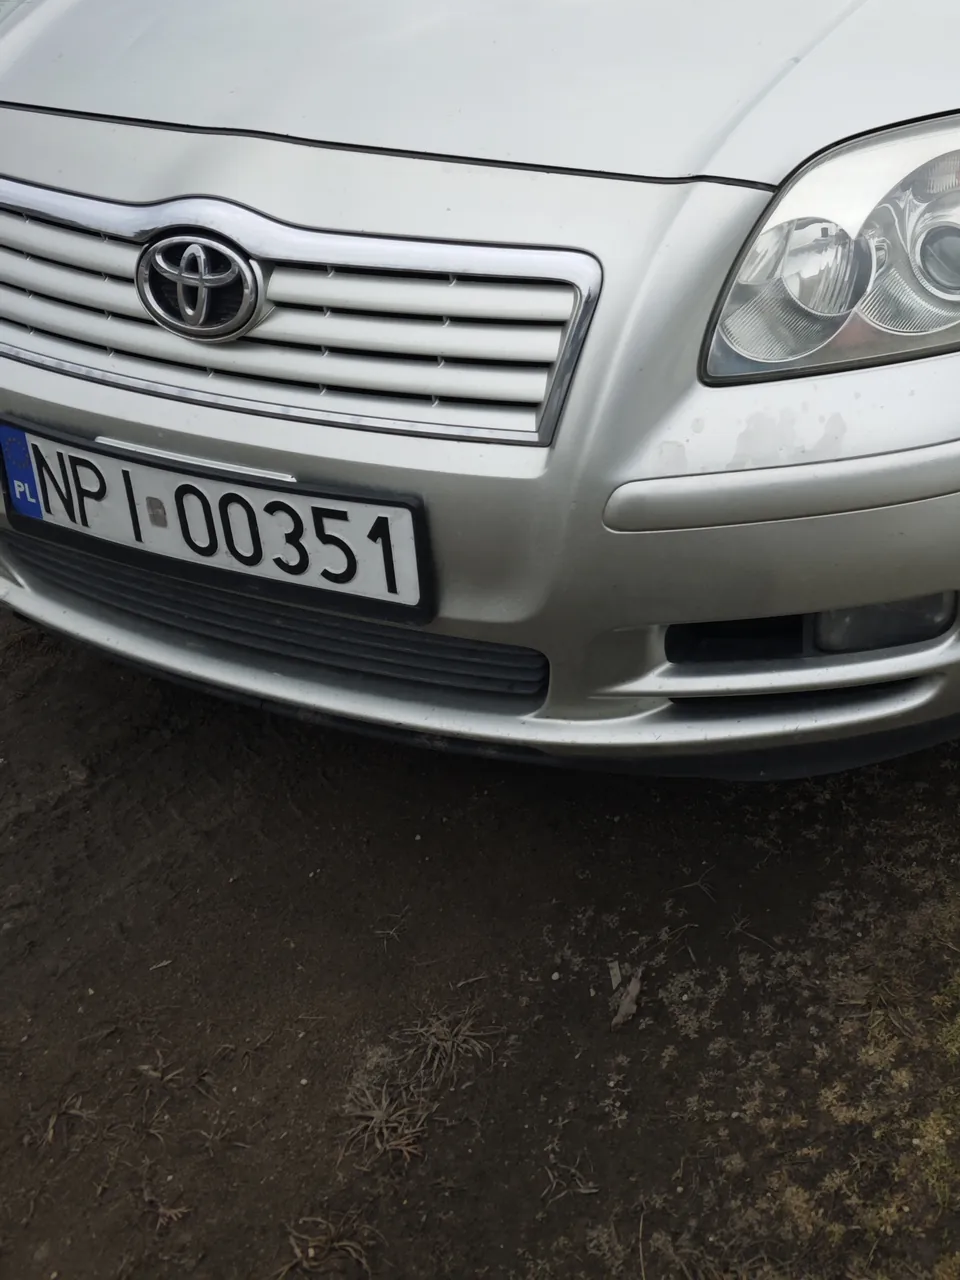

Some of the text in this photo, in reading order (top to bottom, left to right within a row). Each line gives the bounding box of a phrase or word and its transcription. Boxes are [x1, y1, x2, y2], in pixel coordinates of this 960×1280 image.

[13, 480, 36, 503] PL
[31, 443, 397, 594] NPI 00351
